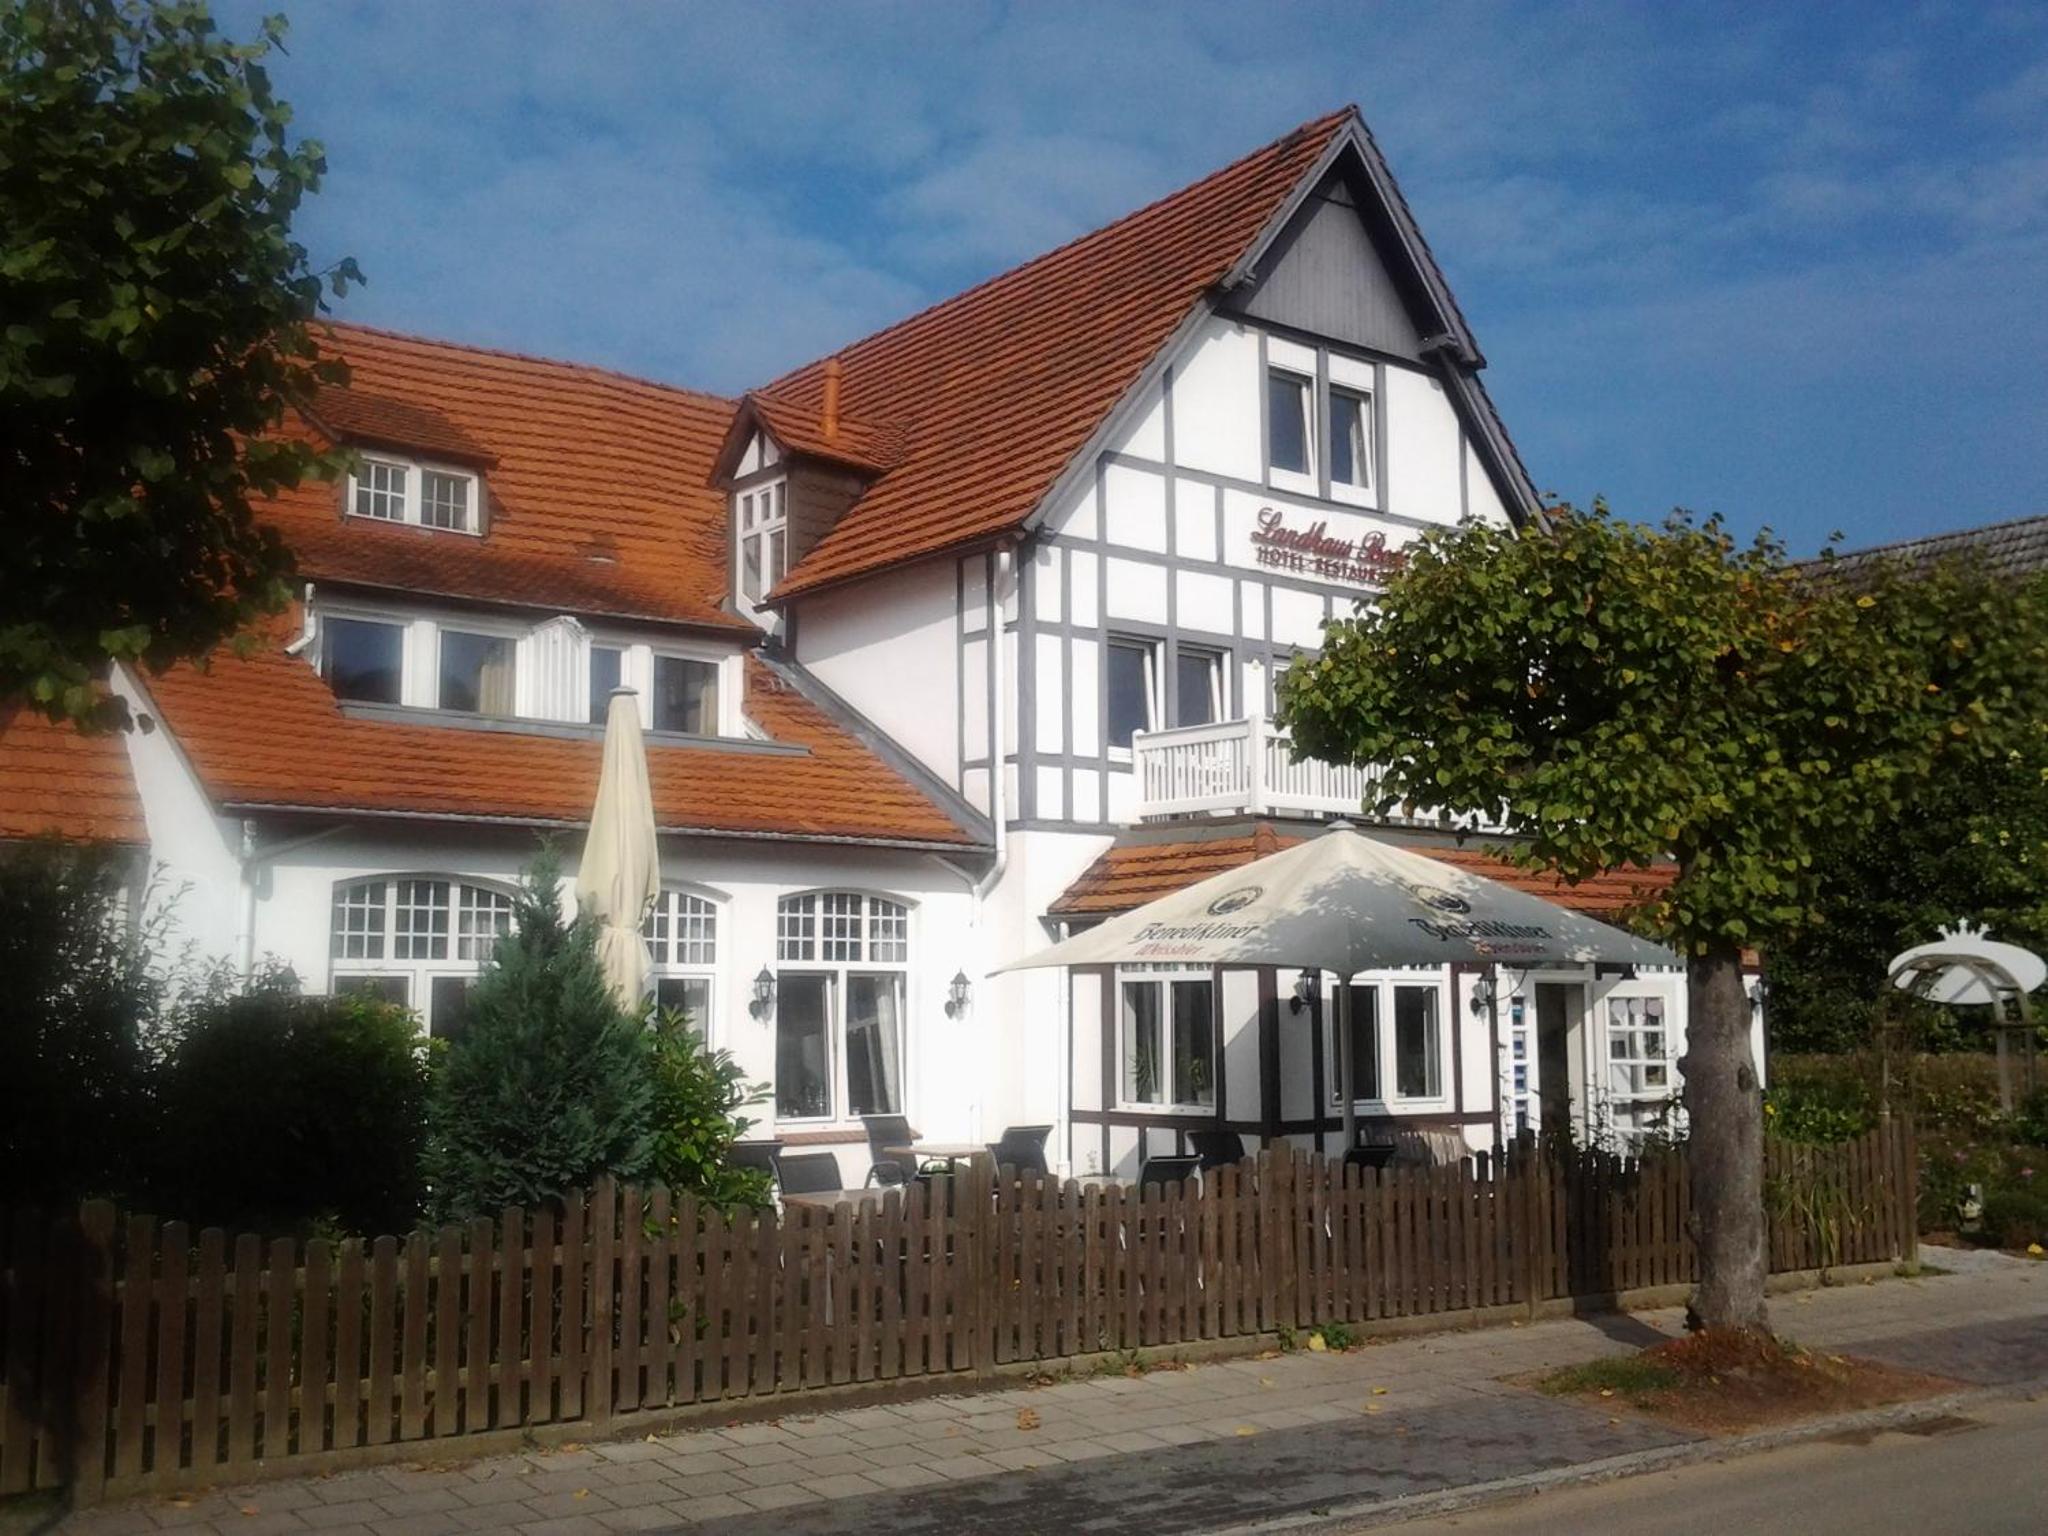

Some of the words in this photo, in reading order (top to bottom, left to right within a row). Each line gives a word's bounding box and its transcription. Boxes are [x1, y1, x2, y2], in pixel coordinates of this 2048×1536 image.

[1251, 507, 1354, 558] Landhaus
[1256, 546, 1304, 572] HOTEL
[1316, 558, 1385, 584] RESTAUR
[1128, 922, 1260, 945] Benediktiner
